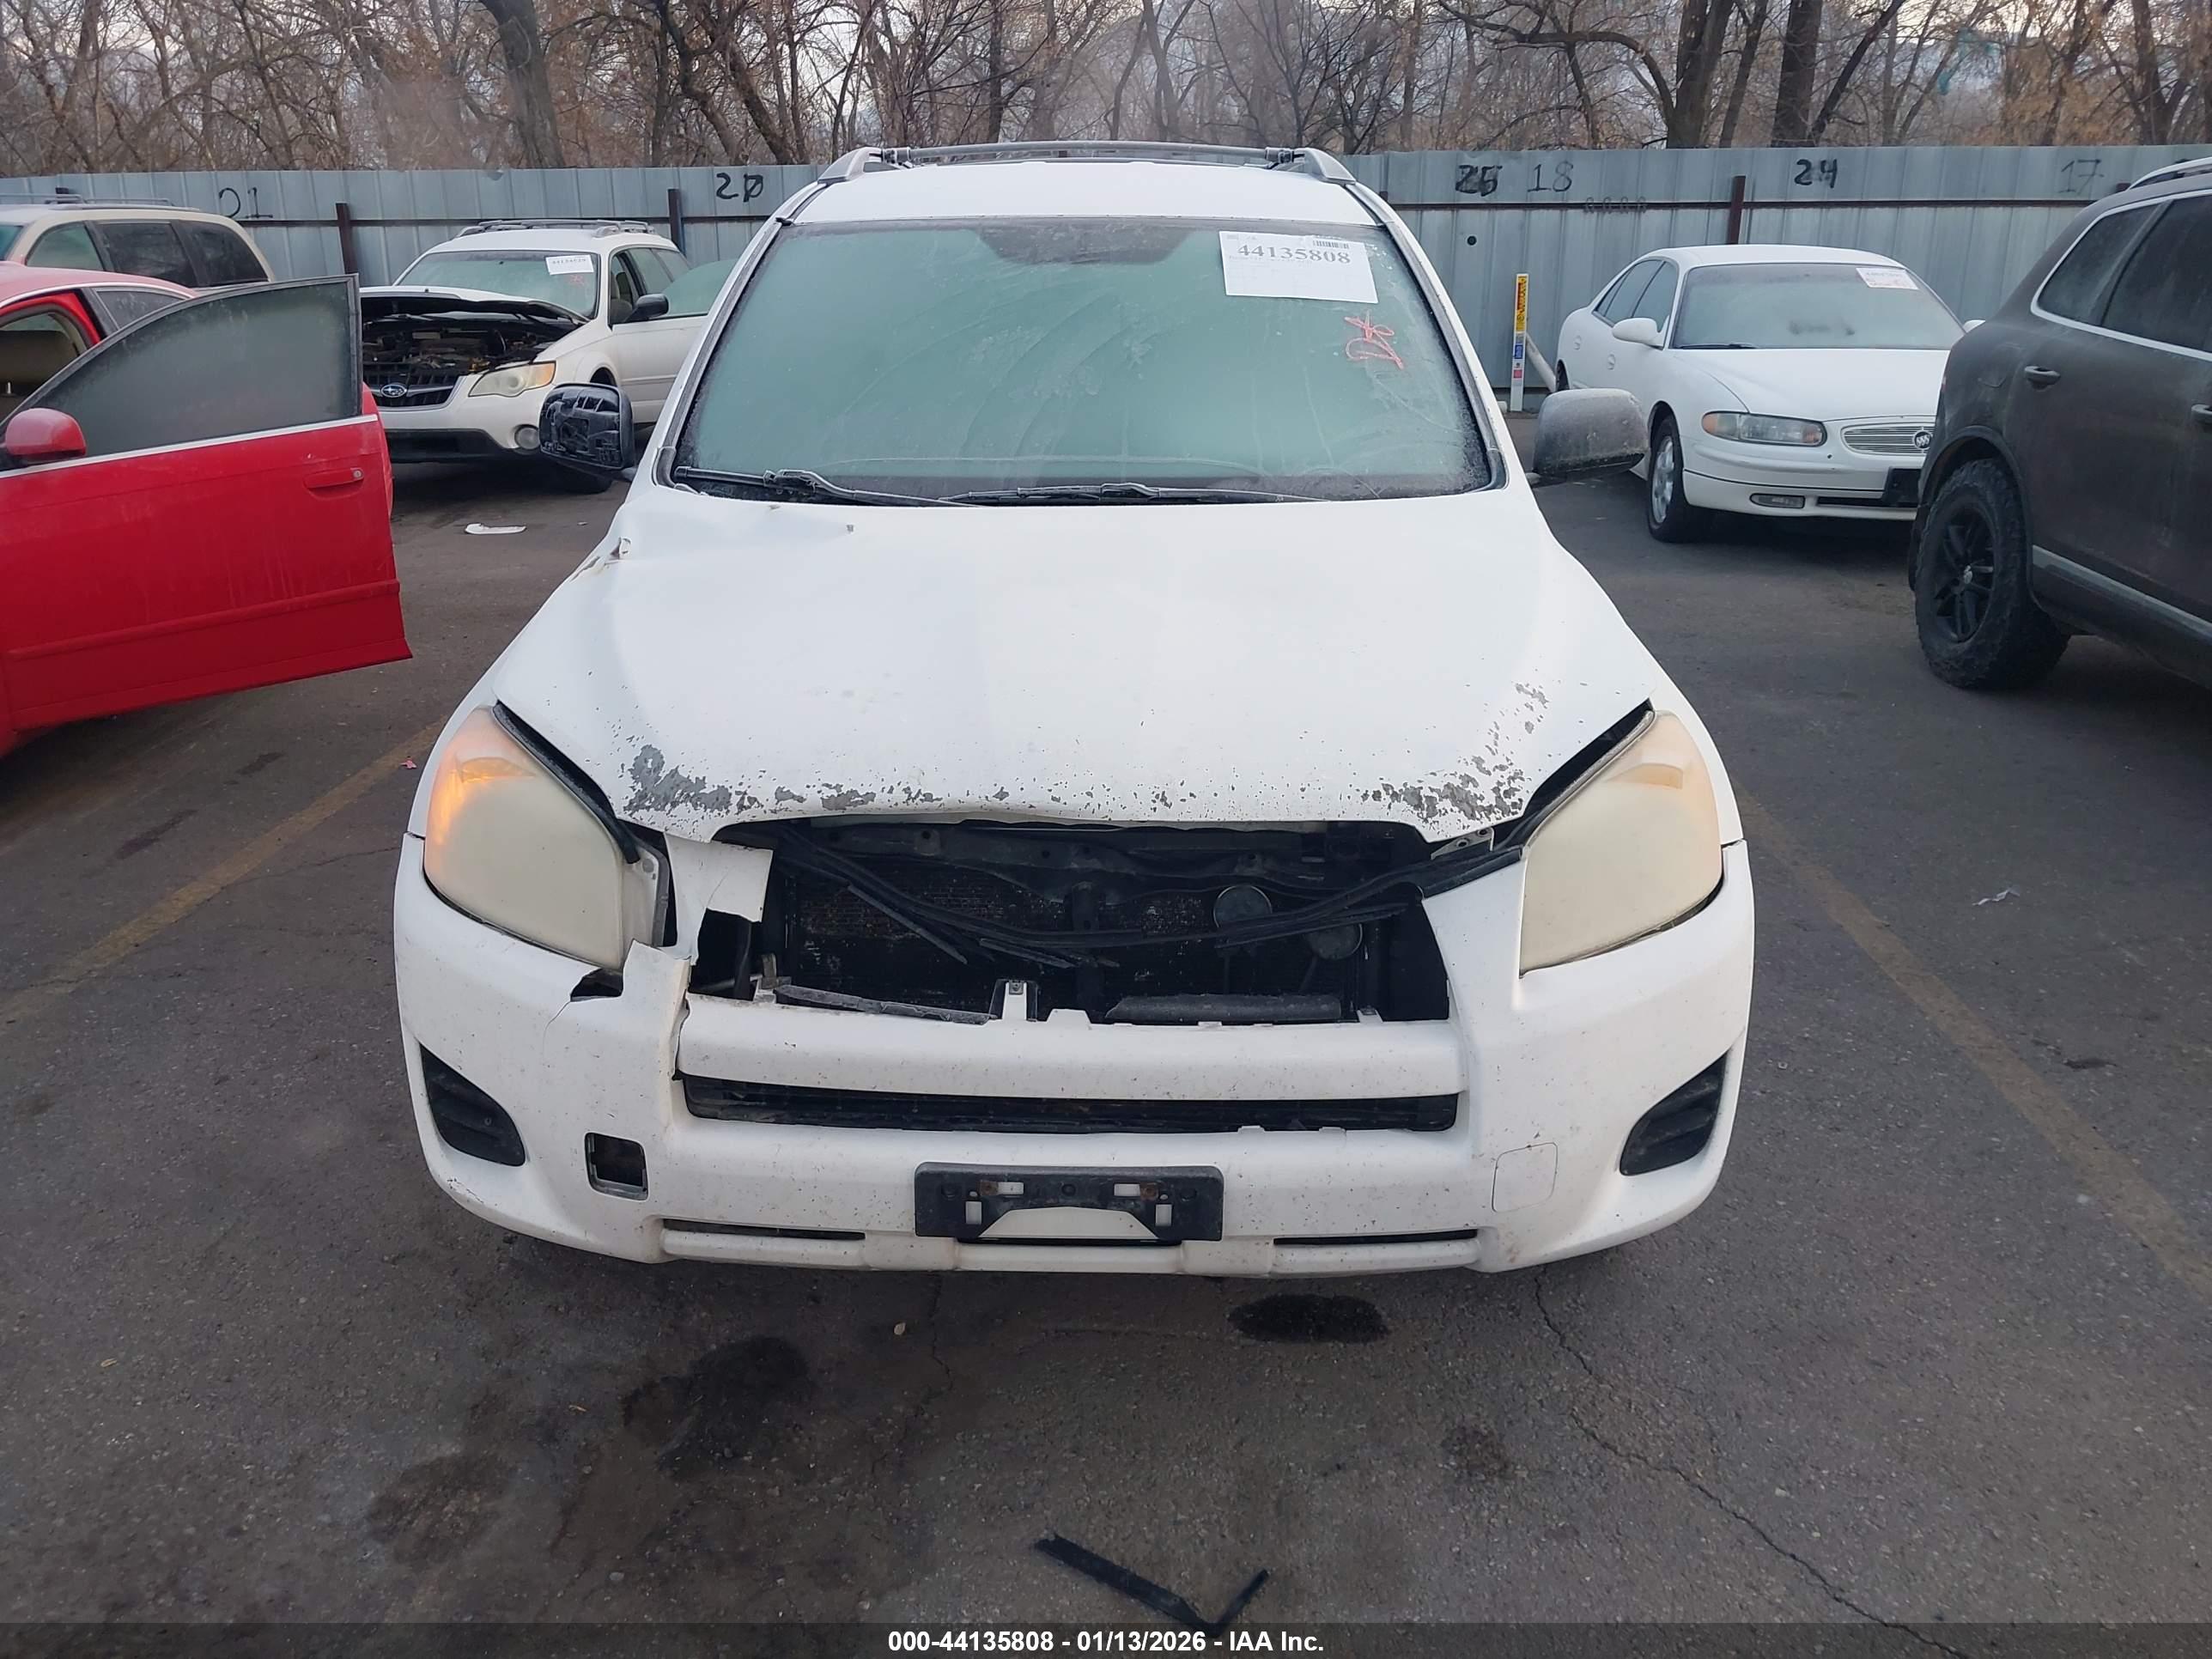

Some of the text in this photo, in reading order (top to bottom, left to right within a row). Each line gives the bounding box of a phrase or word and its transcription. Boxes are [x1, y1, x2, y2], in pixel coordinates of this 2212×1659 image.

[1527, 161, 1574, 192] 18
[1794, 159, 1837, 188] 24
[2058, 160, 2105, 196] 17
[1237, 244, 1352, 264] 44135808
